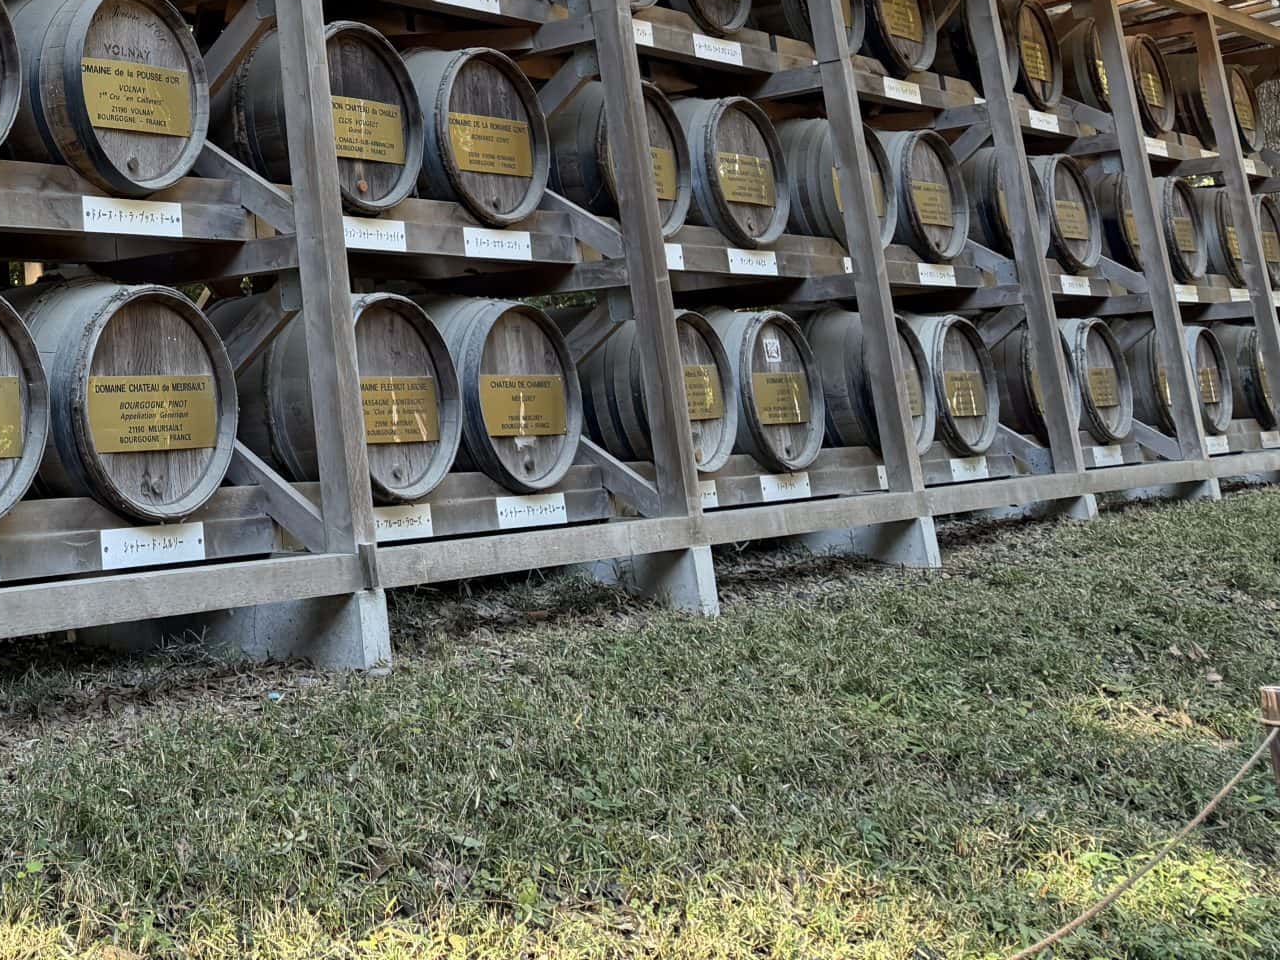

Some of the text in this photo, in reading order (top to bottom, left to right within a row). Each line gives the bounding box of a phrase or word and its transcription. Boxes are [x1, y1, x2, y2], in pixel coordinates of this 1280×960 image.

[103, 42, 151, 60] VOLNAY
[114, 68, 124, 77] de
[136, 70, 162, 82] POUSSE
[119, 84, 146, 95] VOLNAY
[109, 92, 121, 100] Cru
[130, 107, 154, 116] VOLNAY
[97, 113, 167, 127] BOURGOGNE FRANCE
[95, 383, 126, 394] DOMAINE
[172, 382, 206, 392] MEURSAULT
[119, 399, 188, 410] BOURGOGNE PINOT
[148, 423, 183, 433] MEURSAULT
[119, 435, 160, 444] BOURGOGNE
